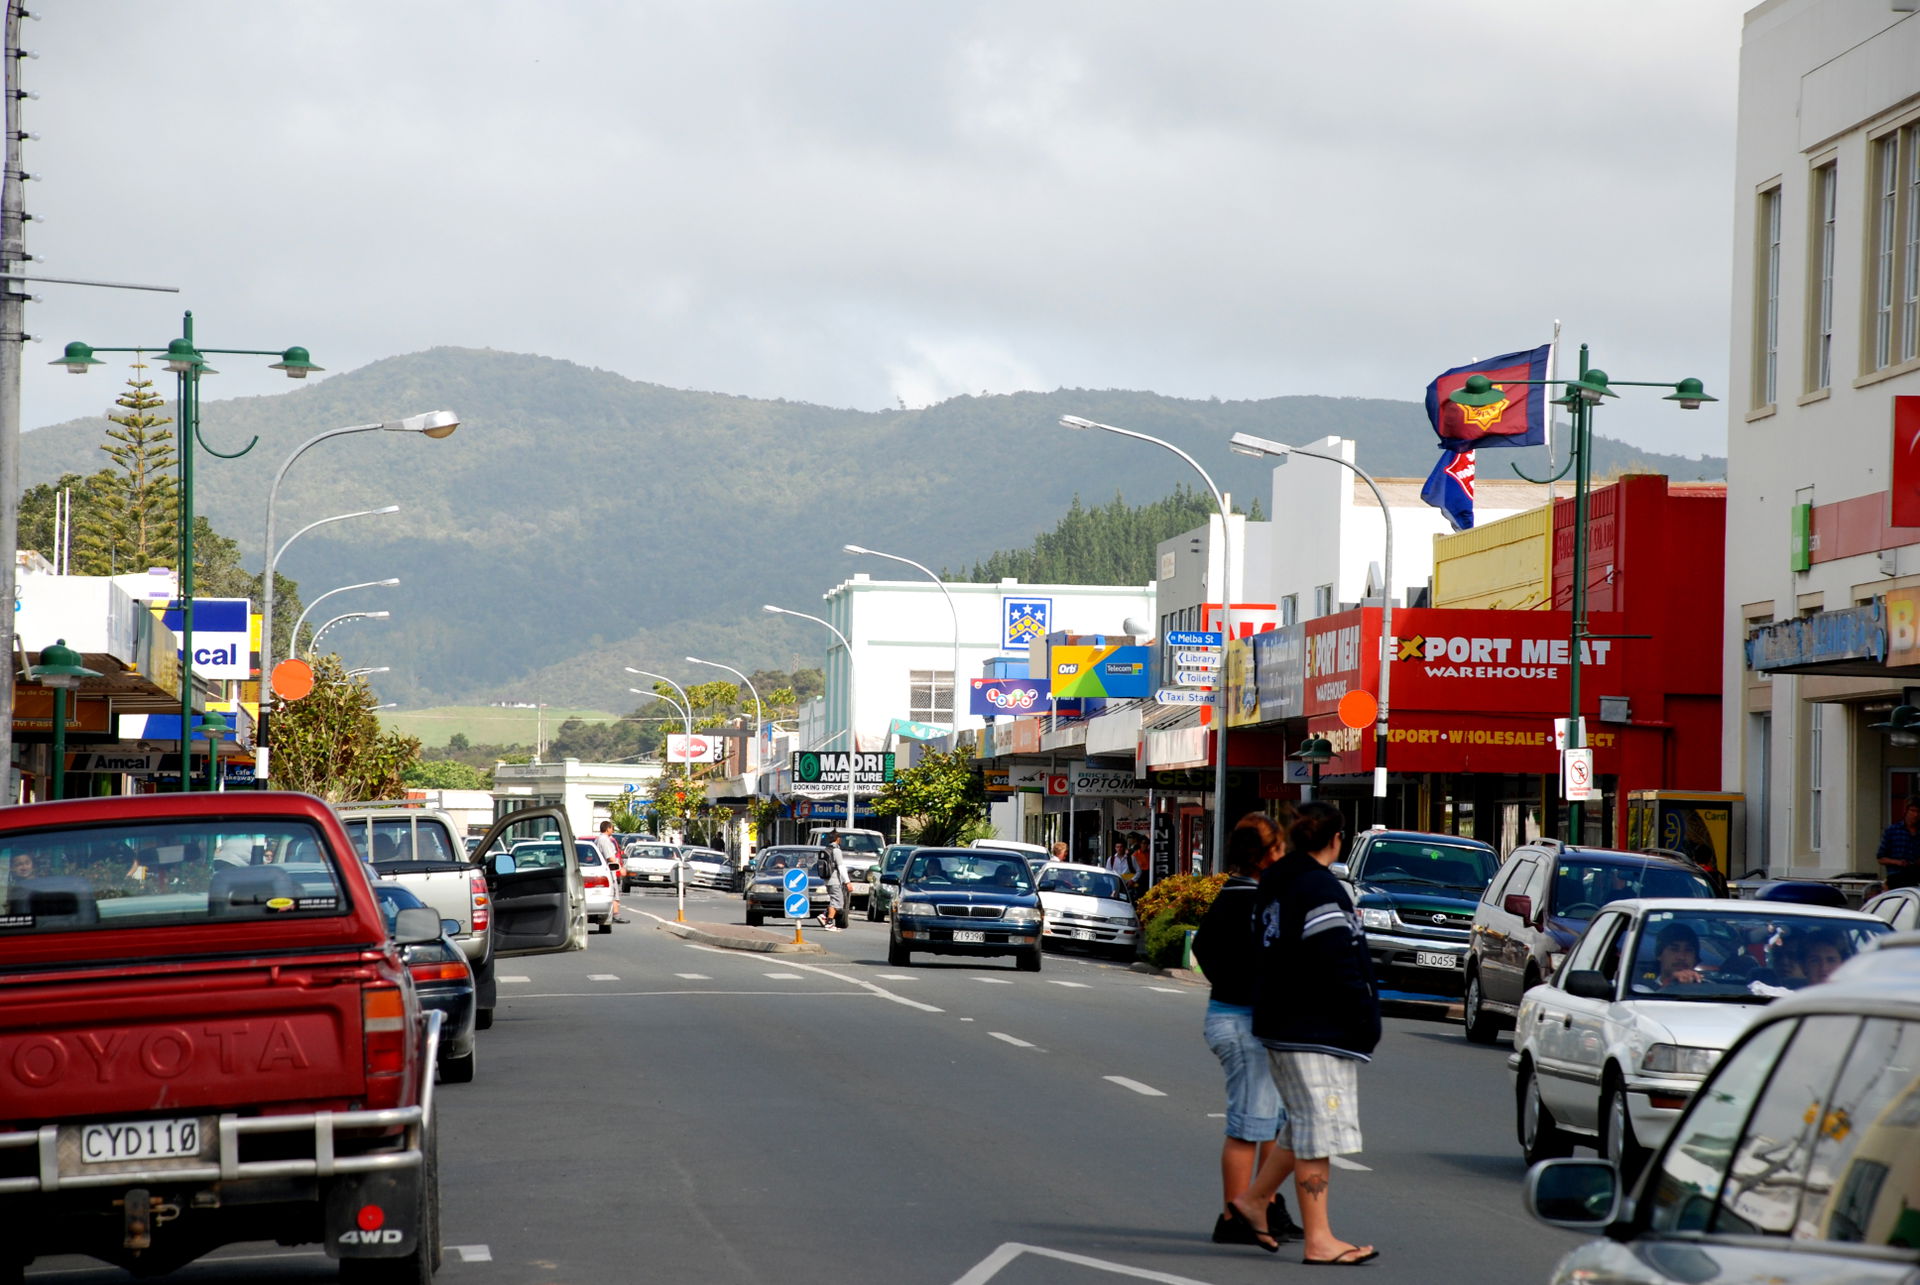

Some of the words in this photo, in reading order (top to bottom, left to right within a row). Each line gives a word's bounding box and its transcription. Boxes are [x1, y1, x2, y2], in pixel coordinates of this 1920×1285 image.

[1178, 635, 1202, 643] Melba
[1205, 635, 1214, 643] St
[1305, 631, 1337, 679] EXPORT
[1338, 625, 1360, 673] MEAT
[1379, 635, 1511, 663] EXPORT
[1521, 639, 1611, 665] MEAT
[1186, 653, 1216, 664] Library
[1107, 664, 1132, 673] Telecom
[1425, 667, 1557, 679] WAREHOUSE
[1187, 674, 1217, 683] Toilets
[1166, 692, 1184, 701] Taxi
[1189, 693, 1215, 702] Stand
[1316, 680, 1347, 702] WAREHOUSE
[987, 689, 1033, 708] LOTTO
[1449, 730, 1545, 746] WHOLESALE
[1587, 733, 1615, 747] ECT
[94, 755, 150, 769] Amcal
[820, 754, 883, 772] MAORI
[885, 753, 895, 782] TOURS
[820, 772, 883, 782] ADVETURE
[814, 805, 832, 813] Tour
[1704, 811, 1727, 821] Card
[0, 1019, 310, 1088] OYOTA
[85, 1121, 197, 1159] CYD110
[338, 1229, 403, 1244] 4WD
